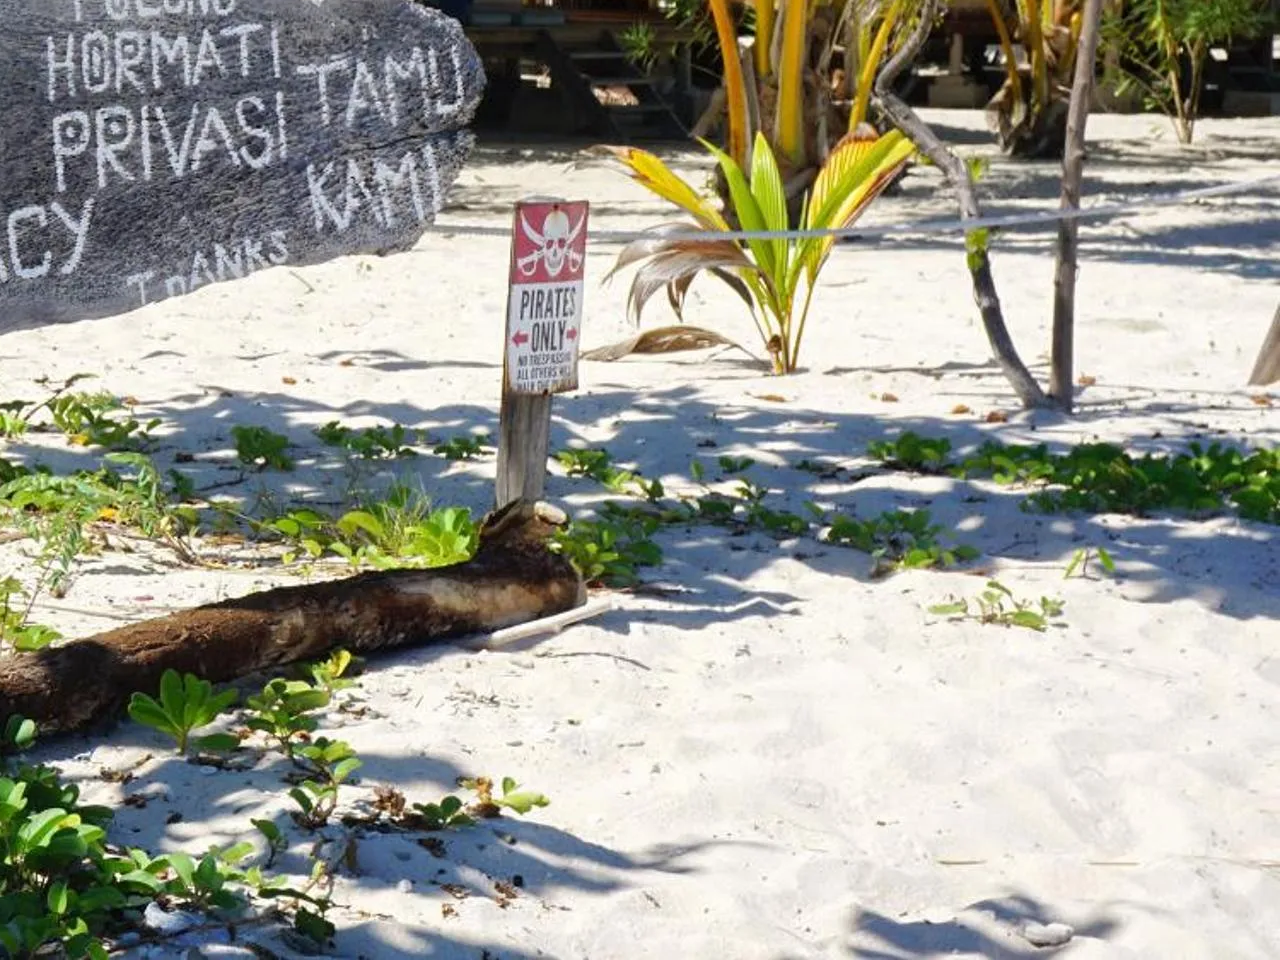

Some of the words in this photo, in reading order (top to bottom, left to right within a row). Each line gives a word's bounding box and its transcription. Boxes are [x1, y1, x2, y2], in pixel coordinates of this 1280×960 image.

[47, 23, 282, 102] HORMATI
[296, 44, 465, 127] TAMU
[52, 90, 287, 192] PRIVASI
[306, 143, 442, 232] KAMI
[520, 286, 577, 321] PIRATES
[531, 320, 568, 352] ONLY
[516, 367, 529, 380] ALL
[531, 365, 557, 379] OTHERS
[518, 354, 528, 367] NO
